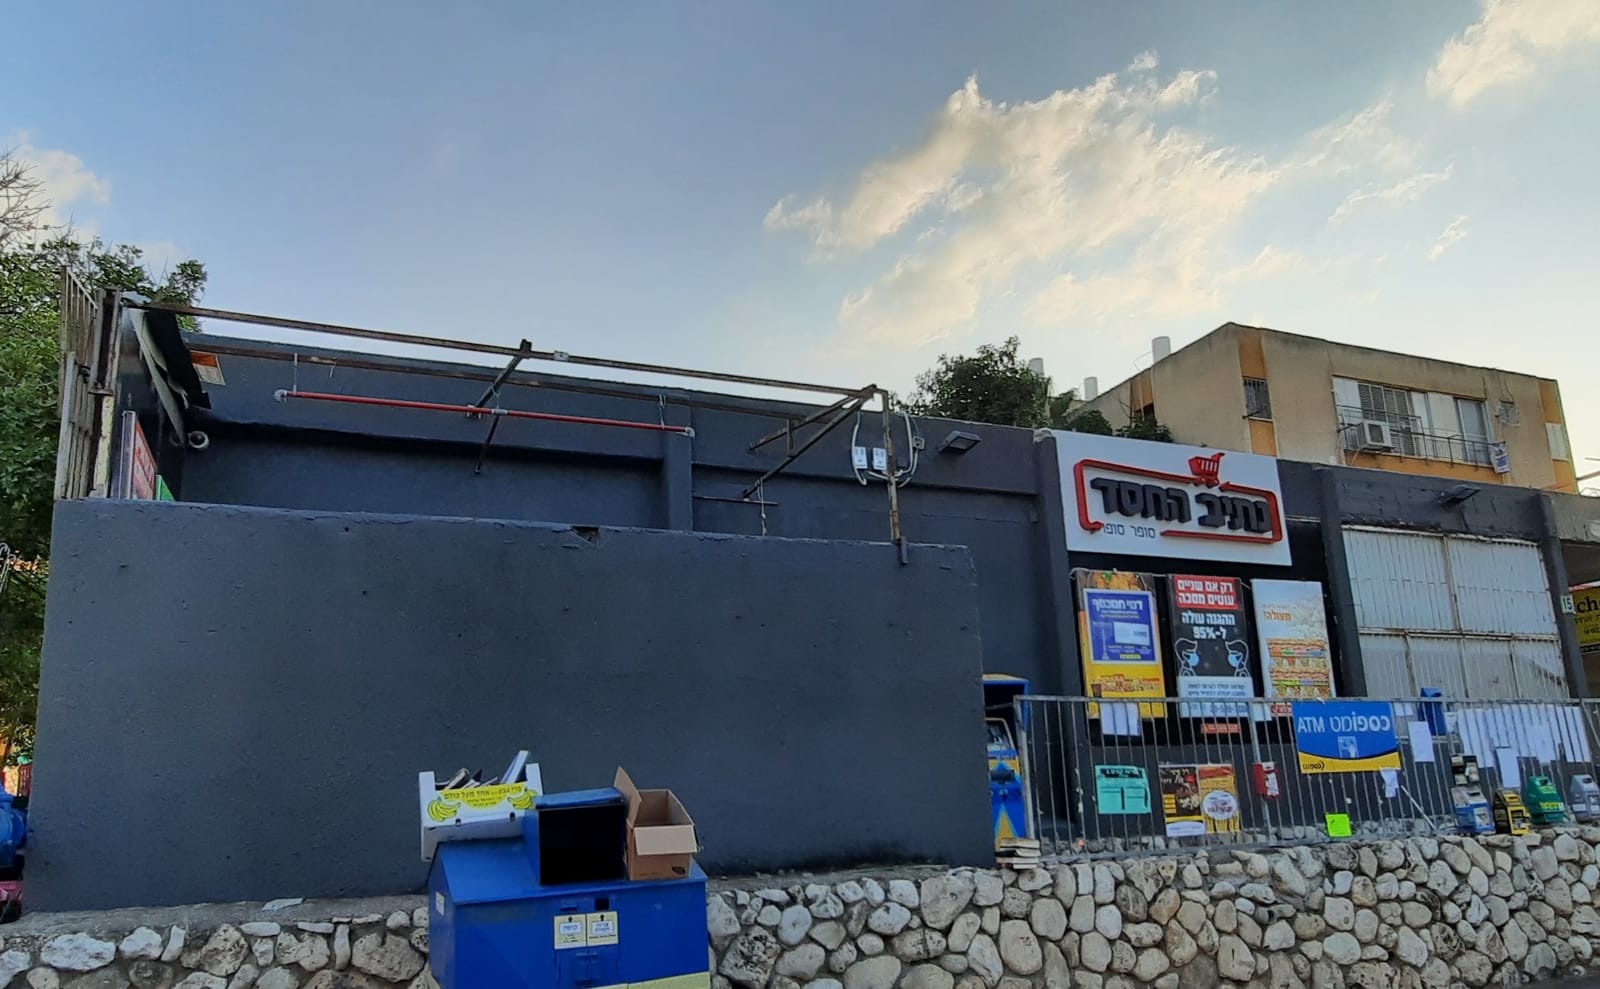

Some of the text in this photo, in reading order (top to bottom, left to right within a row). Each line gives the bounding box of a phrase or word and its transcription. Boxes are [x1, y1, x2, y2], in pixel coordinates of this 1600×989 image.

[1090, 477, 1272, 534] נתיב החסד
[1130, 525, 1156, 539] סופר
[1178, 579, 1233, 595] רק אם שניים
[1178, 592, 1235, 606] עוטים מסכה
[1562, 597, 1573, 610] 15
[1576, 595, 1600, 613] ch
[1206, 613, 1236, 625] ההגנה
[1297, 716, 1326, 733] ATM
